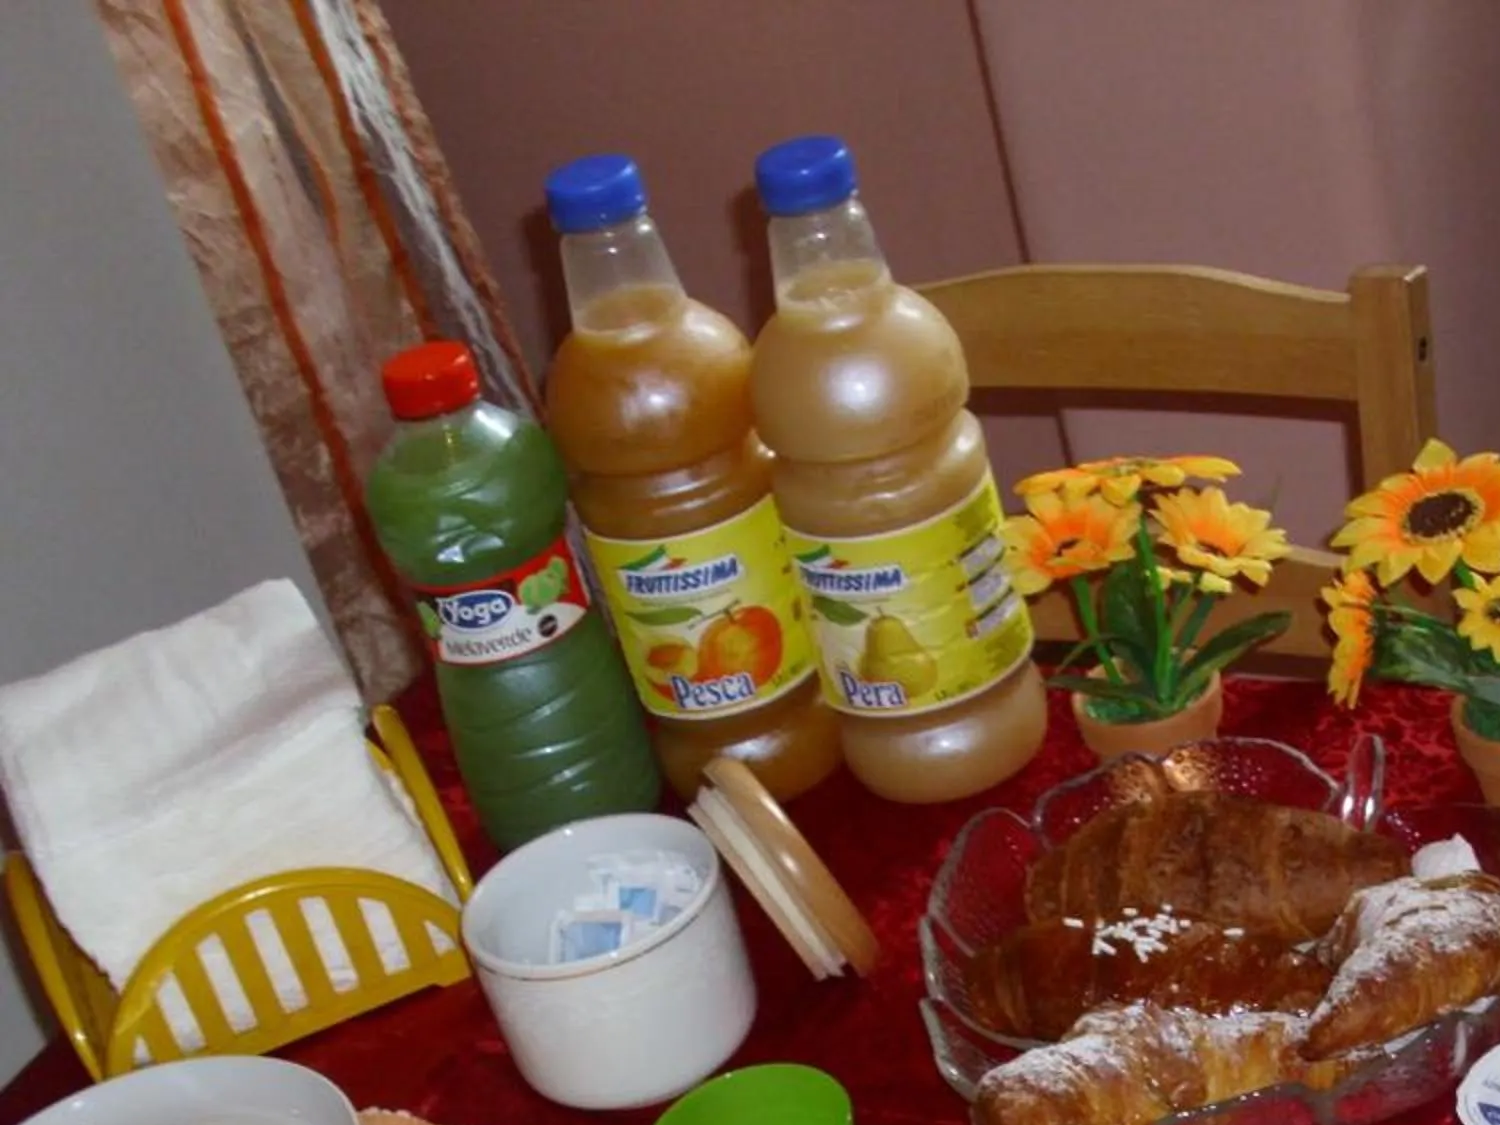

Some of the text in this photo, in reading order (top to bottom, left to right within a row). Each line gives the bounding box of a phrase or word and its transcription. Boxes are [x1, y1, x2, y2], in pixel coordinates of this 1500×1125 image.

[626, 556, 738, 594] FRUTTISSIMA
[440, 598, 507, 625] Yoga
[670, 673, 754, 708] Pesca
[840, 671, 904, 706] Pera
